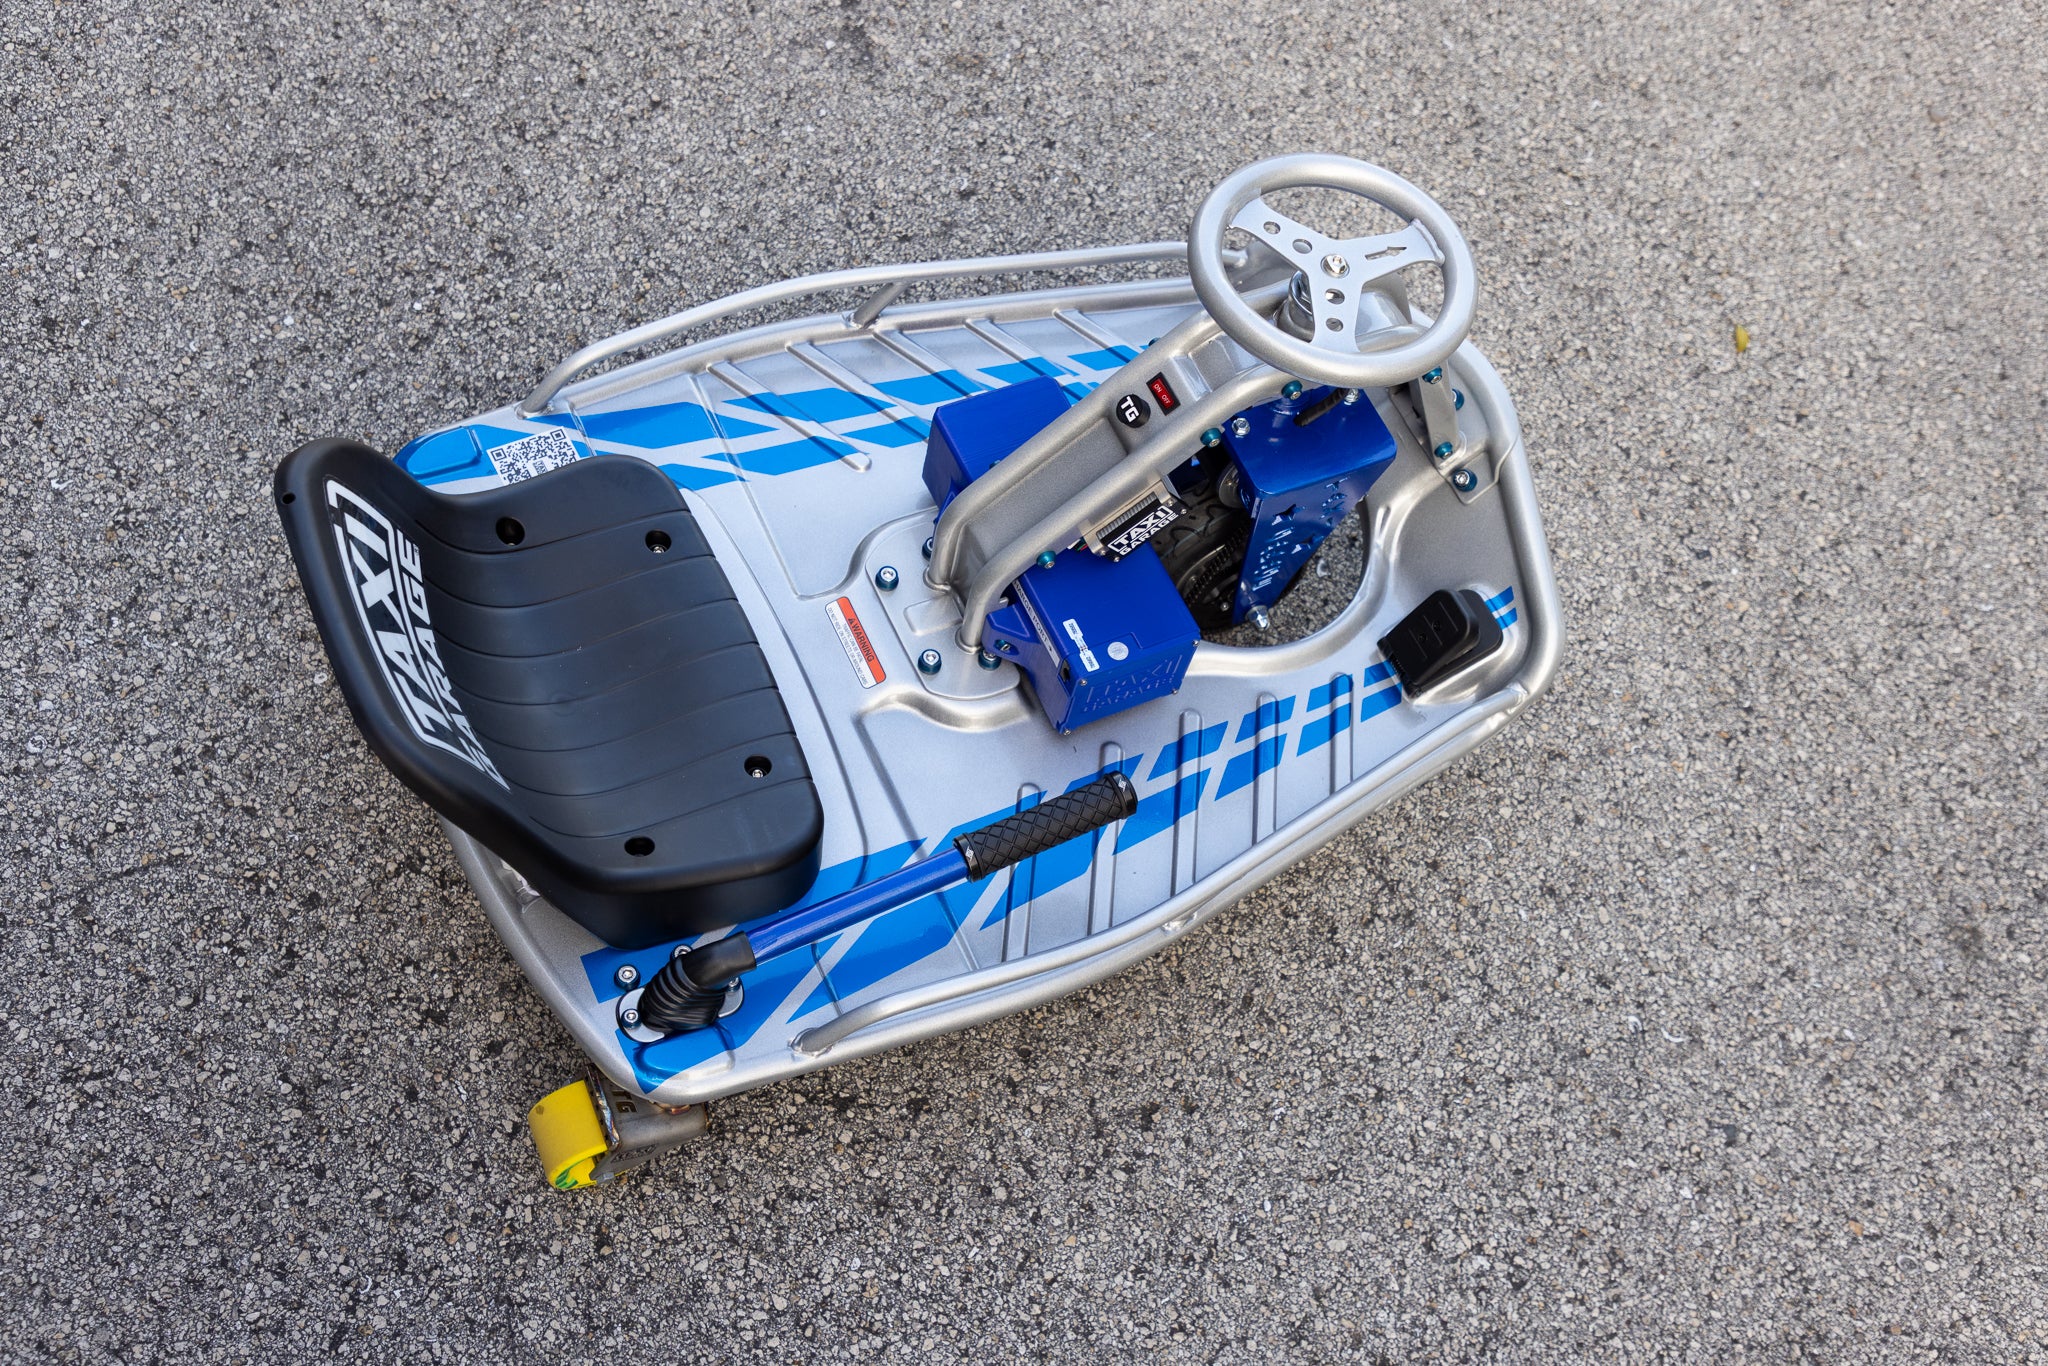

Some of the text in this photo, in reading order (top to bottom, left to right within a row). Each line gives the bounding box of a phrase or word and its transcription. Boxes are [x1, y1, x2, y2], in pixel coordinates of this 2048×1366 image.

[1120, 396, 1140, 422] TG
[1154, 384, 1170, 404] ON OFF
[1113, 510, 1168, 547] TAXI
[1119, 512, 1179, 555] GARAGE
[1013, 580, 1032, 613] HARGE
[341, 508, 456, 736] TAXI
[396, 528, 511, 791] GARAGE
[852, 624, 875, 662] WARNING
